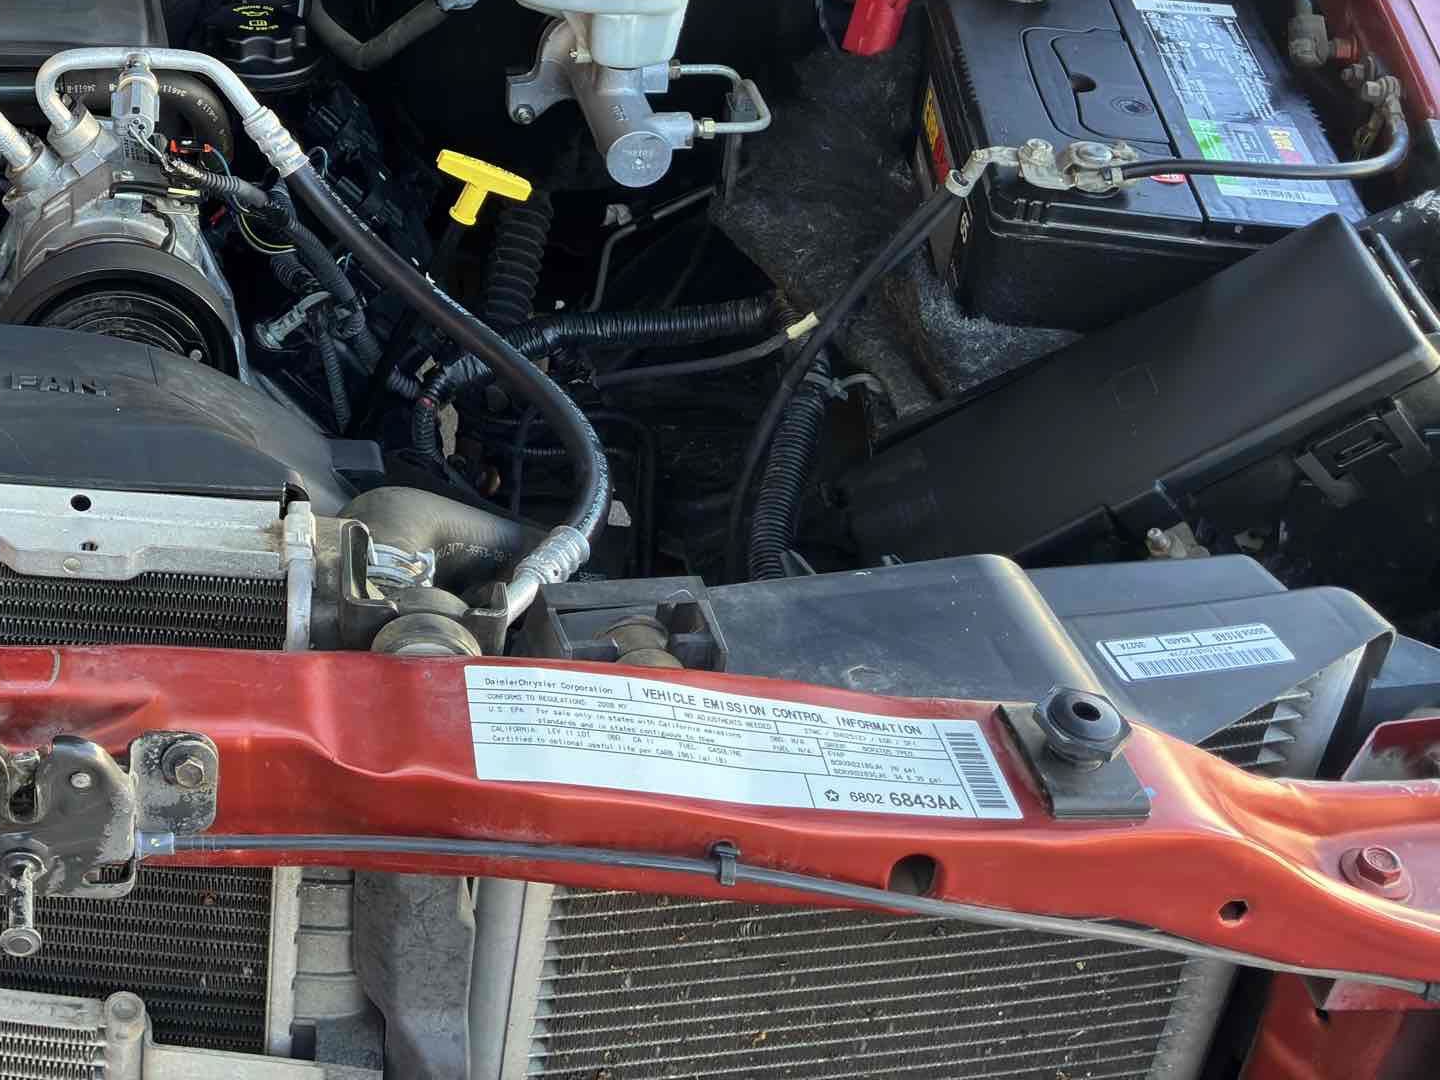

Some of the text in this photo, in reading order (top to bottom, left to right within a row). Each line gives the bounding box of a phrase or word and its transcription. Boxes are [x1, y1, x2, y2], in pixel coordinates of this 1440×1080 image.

[10, 373, 112, 398] FAN
[485, 678, 922, 735] DaimlerChrysler Corporation VEHICLE EMISSION CONTROL INFORMATION
[849, 791, 962, 811] 6802 6843AA
